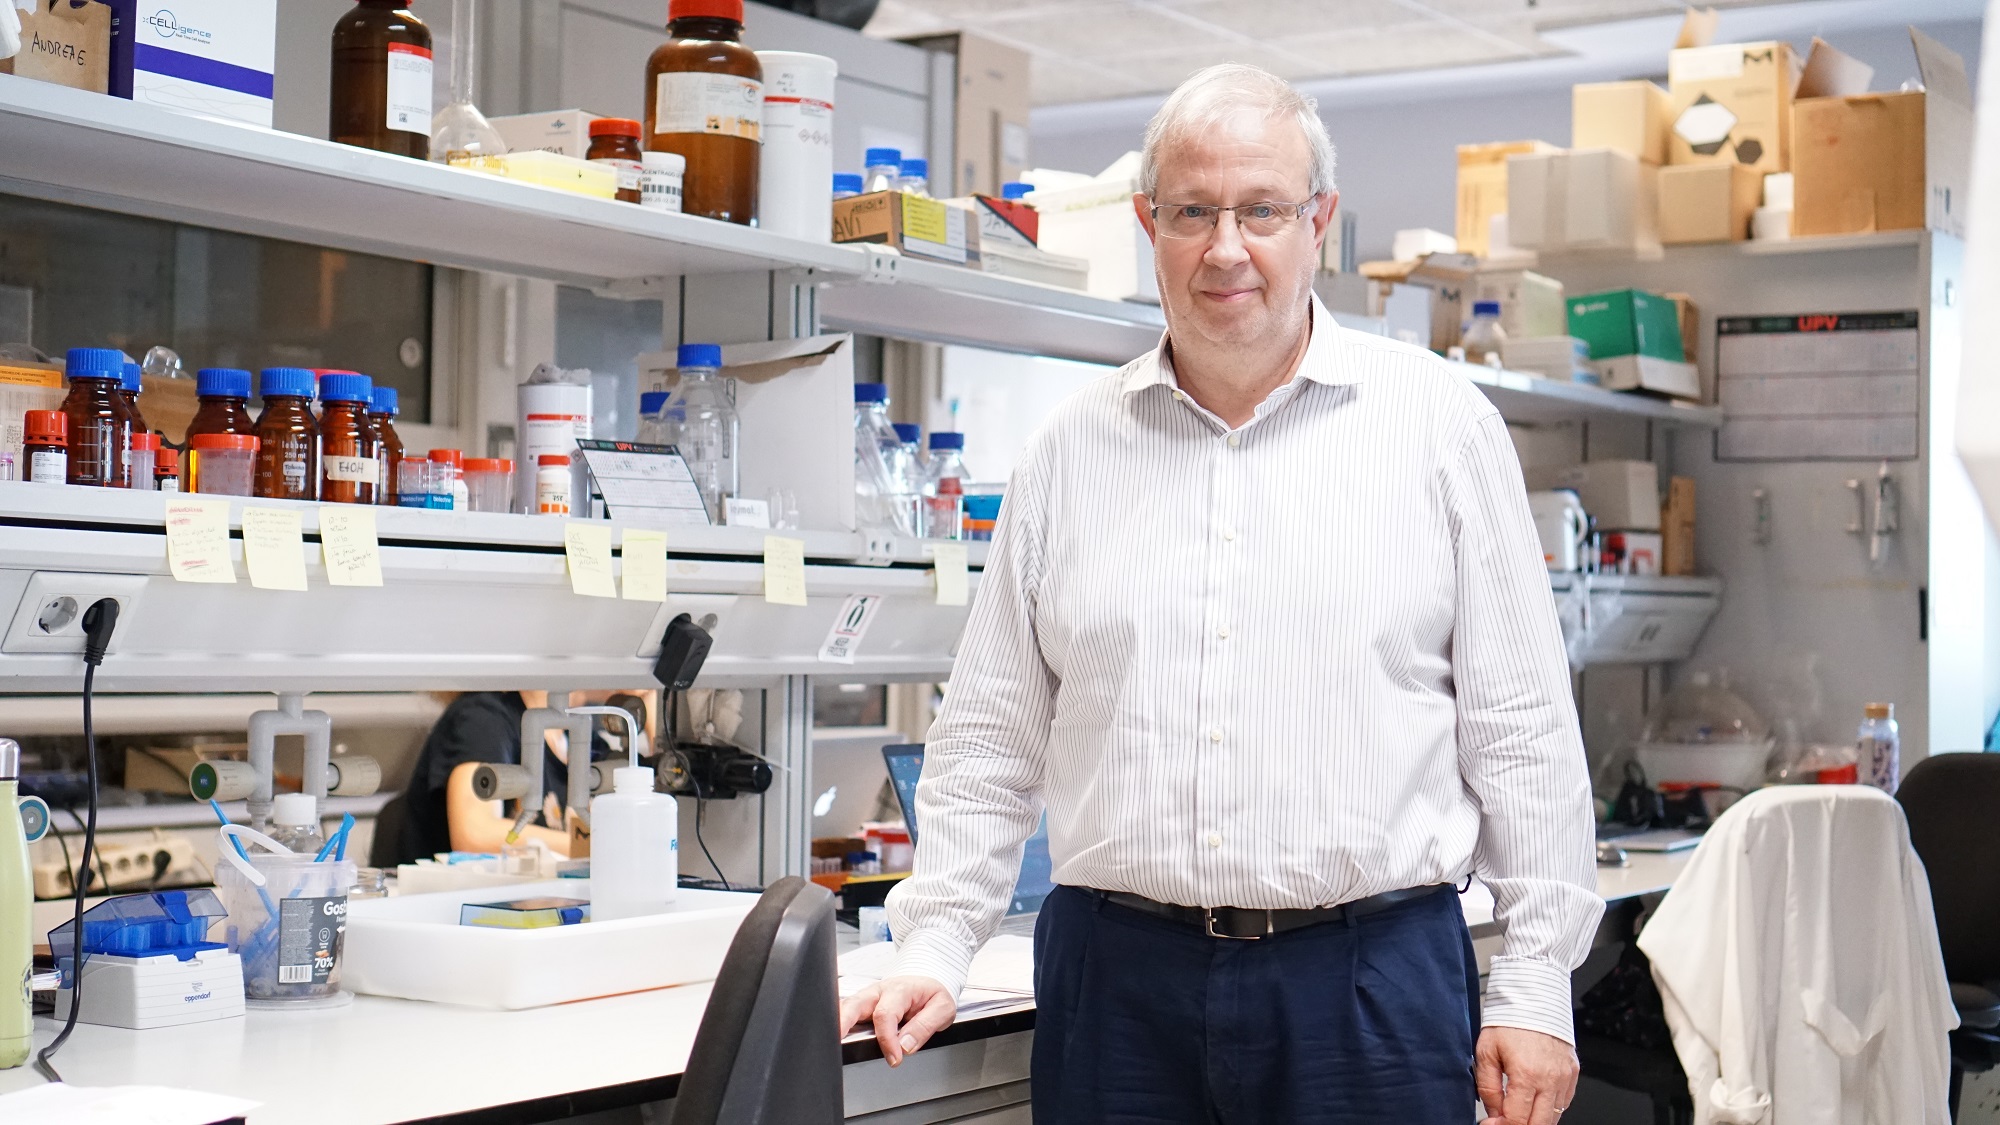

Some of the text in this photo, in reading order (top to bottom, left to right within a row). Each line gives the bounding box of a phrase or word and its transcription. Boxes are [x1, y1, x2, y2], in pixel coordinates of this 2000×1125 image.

[1797, 314, 1840, 331] UPV
[616, 442, 633, 451] UPV
[338, 461, 364, 474] EtOH
[314, 956, 334, 969] 70%
[184, 991, 211, 1004] eppendorf
